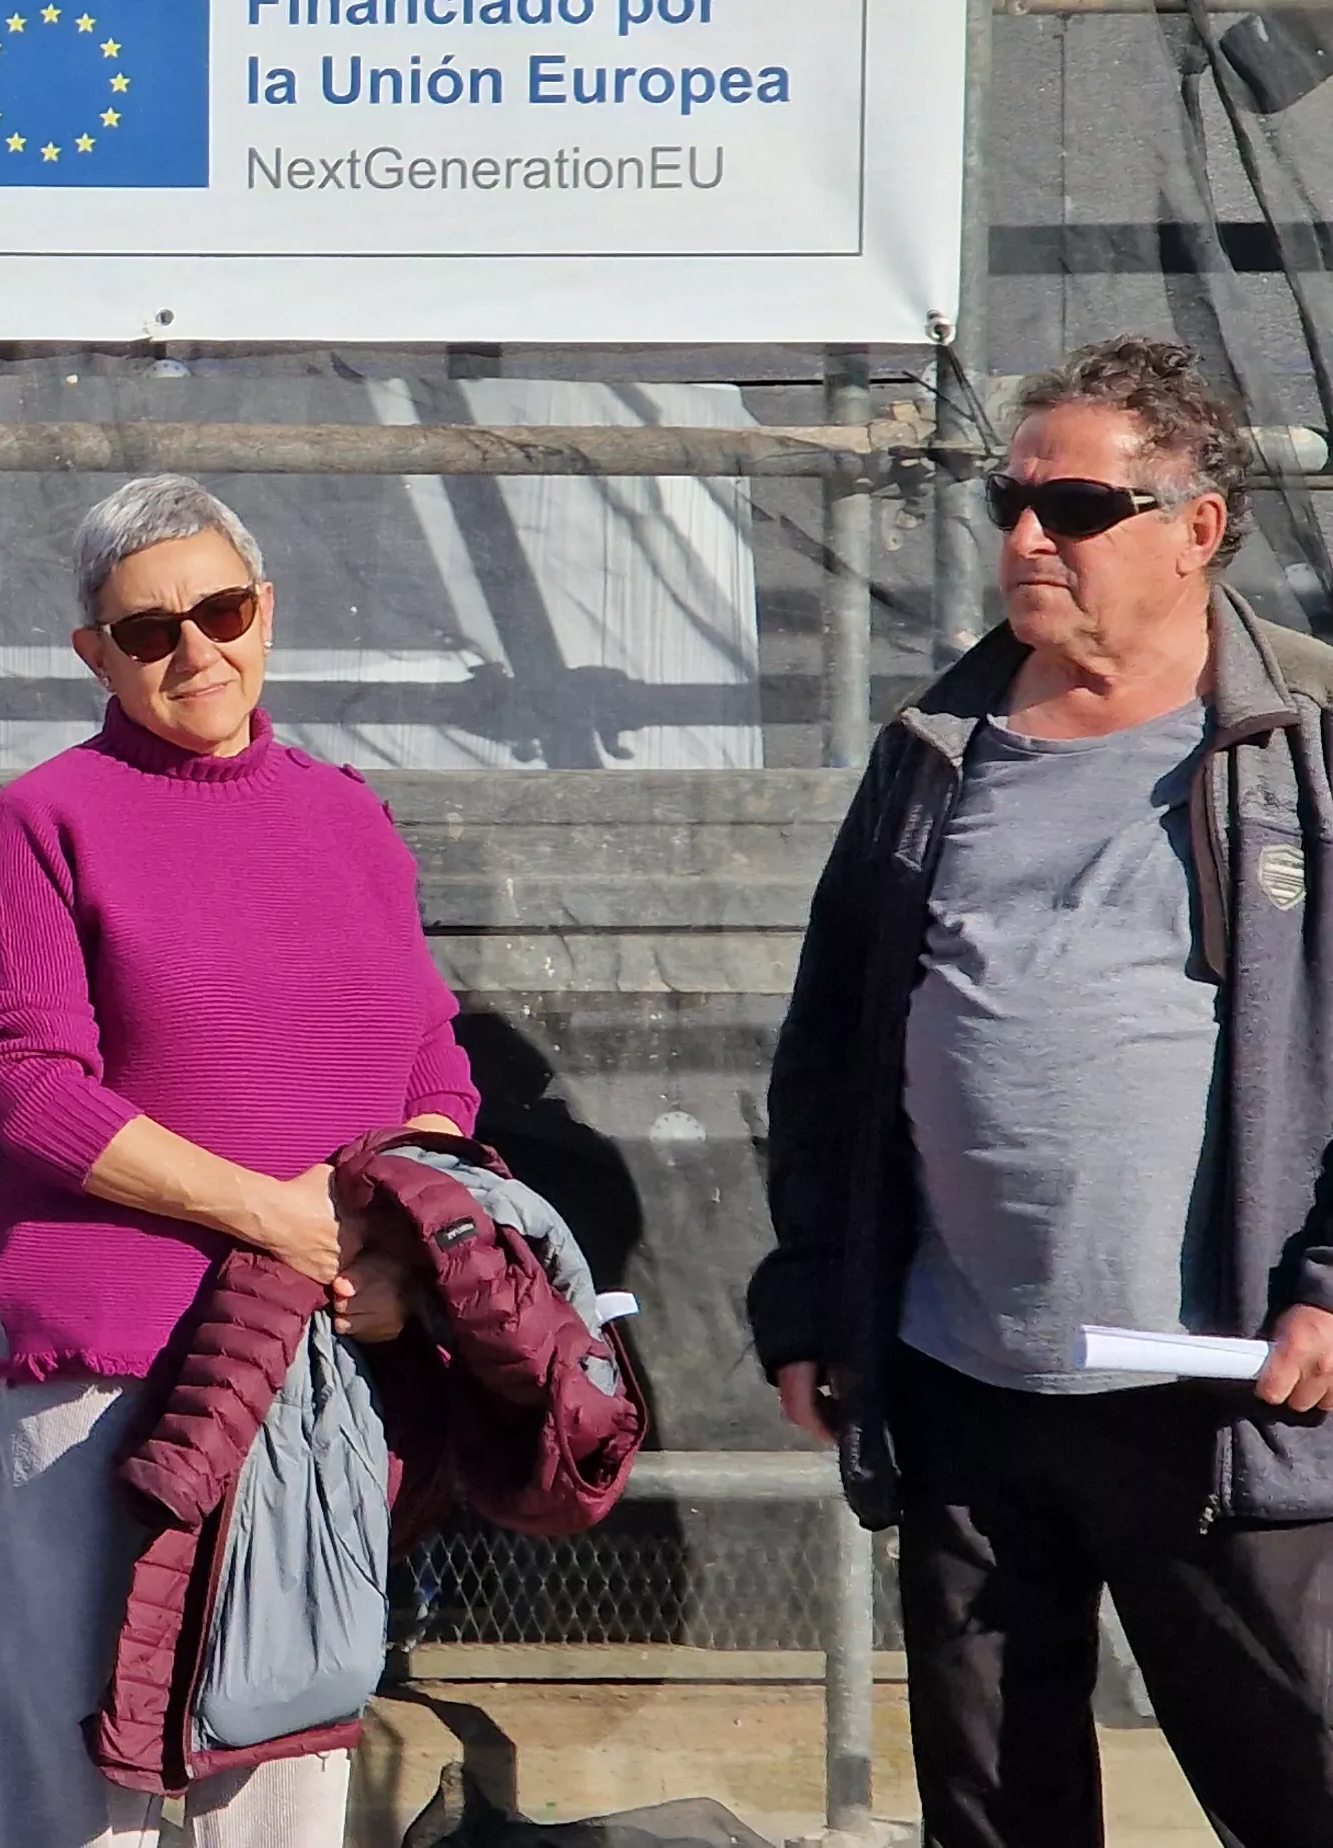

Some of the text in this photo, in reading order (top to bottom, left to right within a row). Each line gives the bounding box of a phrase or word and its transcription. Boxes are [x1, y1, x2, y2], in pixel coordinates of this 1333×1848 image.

[618, 0, 713, 37] por
[248, 54, 791, 116] la Unión Europea
[247, 146, 724, 191] NextGenerationEU
